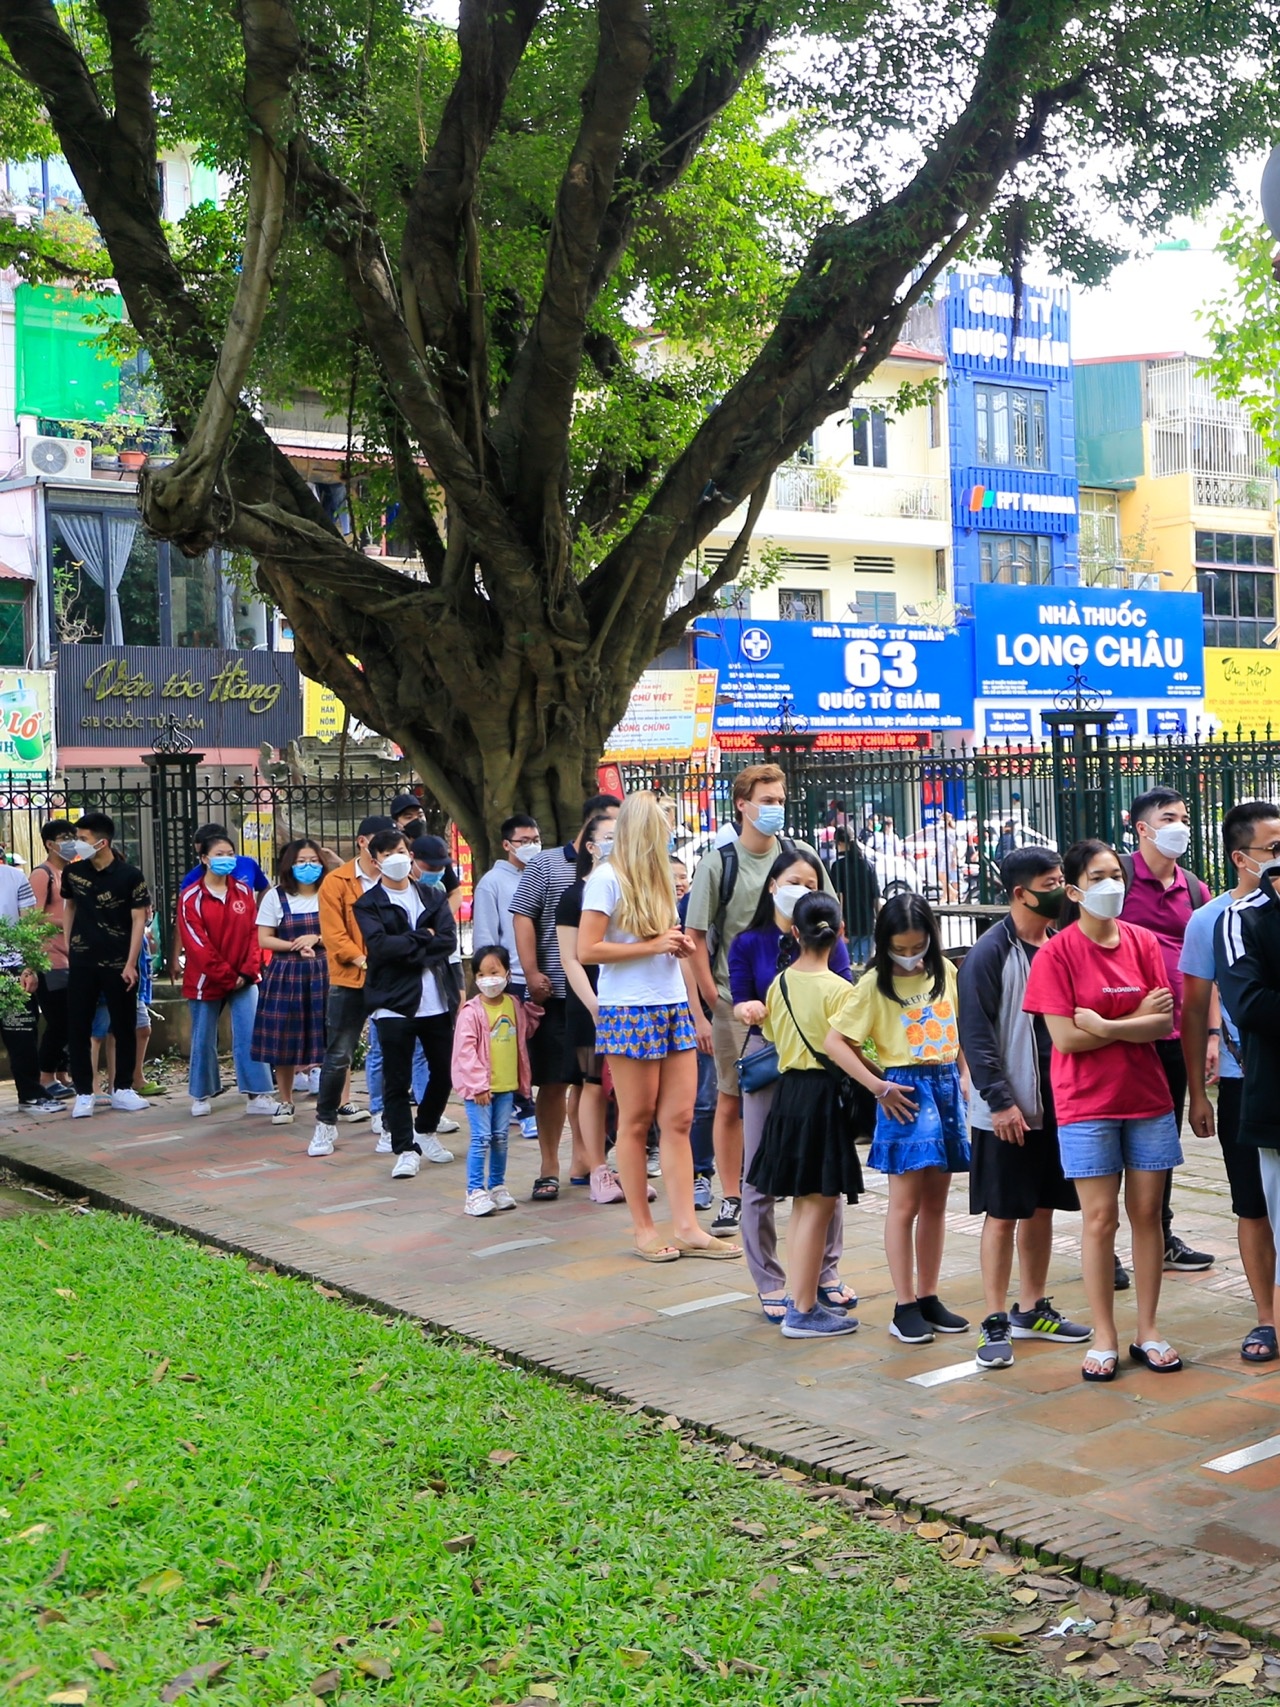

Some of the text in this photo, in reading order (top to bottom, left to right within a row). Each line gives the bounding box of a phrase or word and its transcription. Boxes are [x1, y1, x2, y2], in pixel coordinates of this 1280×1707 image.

[1039, 599, 1147, 627] NHÀ THUỐC
[812, 626, 841, 639] NHÀ
[844, 624, 886, 640] THUỐC
[996, 629, 1184, 668] LONG CHÂU
[844, 640, 917, 688] 63
[84, 658, 154, 704] Viện
[161, 669, 205, 698] tóc
[818, 687, 940, 710] QUỐC TỬ GIÁM
[103, 711, 144, 729] QUỐC
[147, 713, 165, 728] TỬ
[720, 733, 756, 747] THUỐC
[898, 735, 917, 745] GPP
